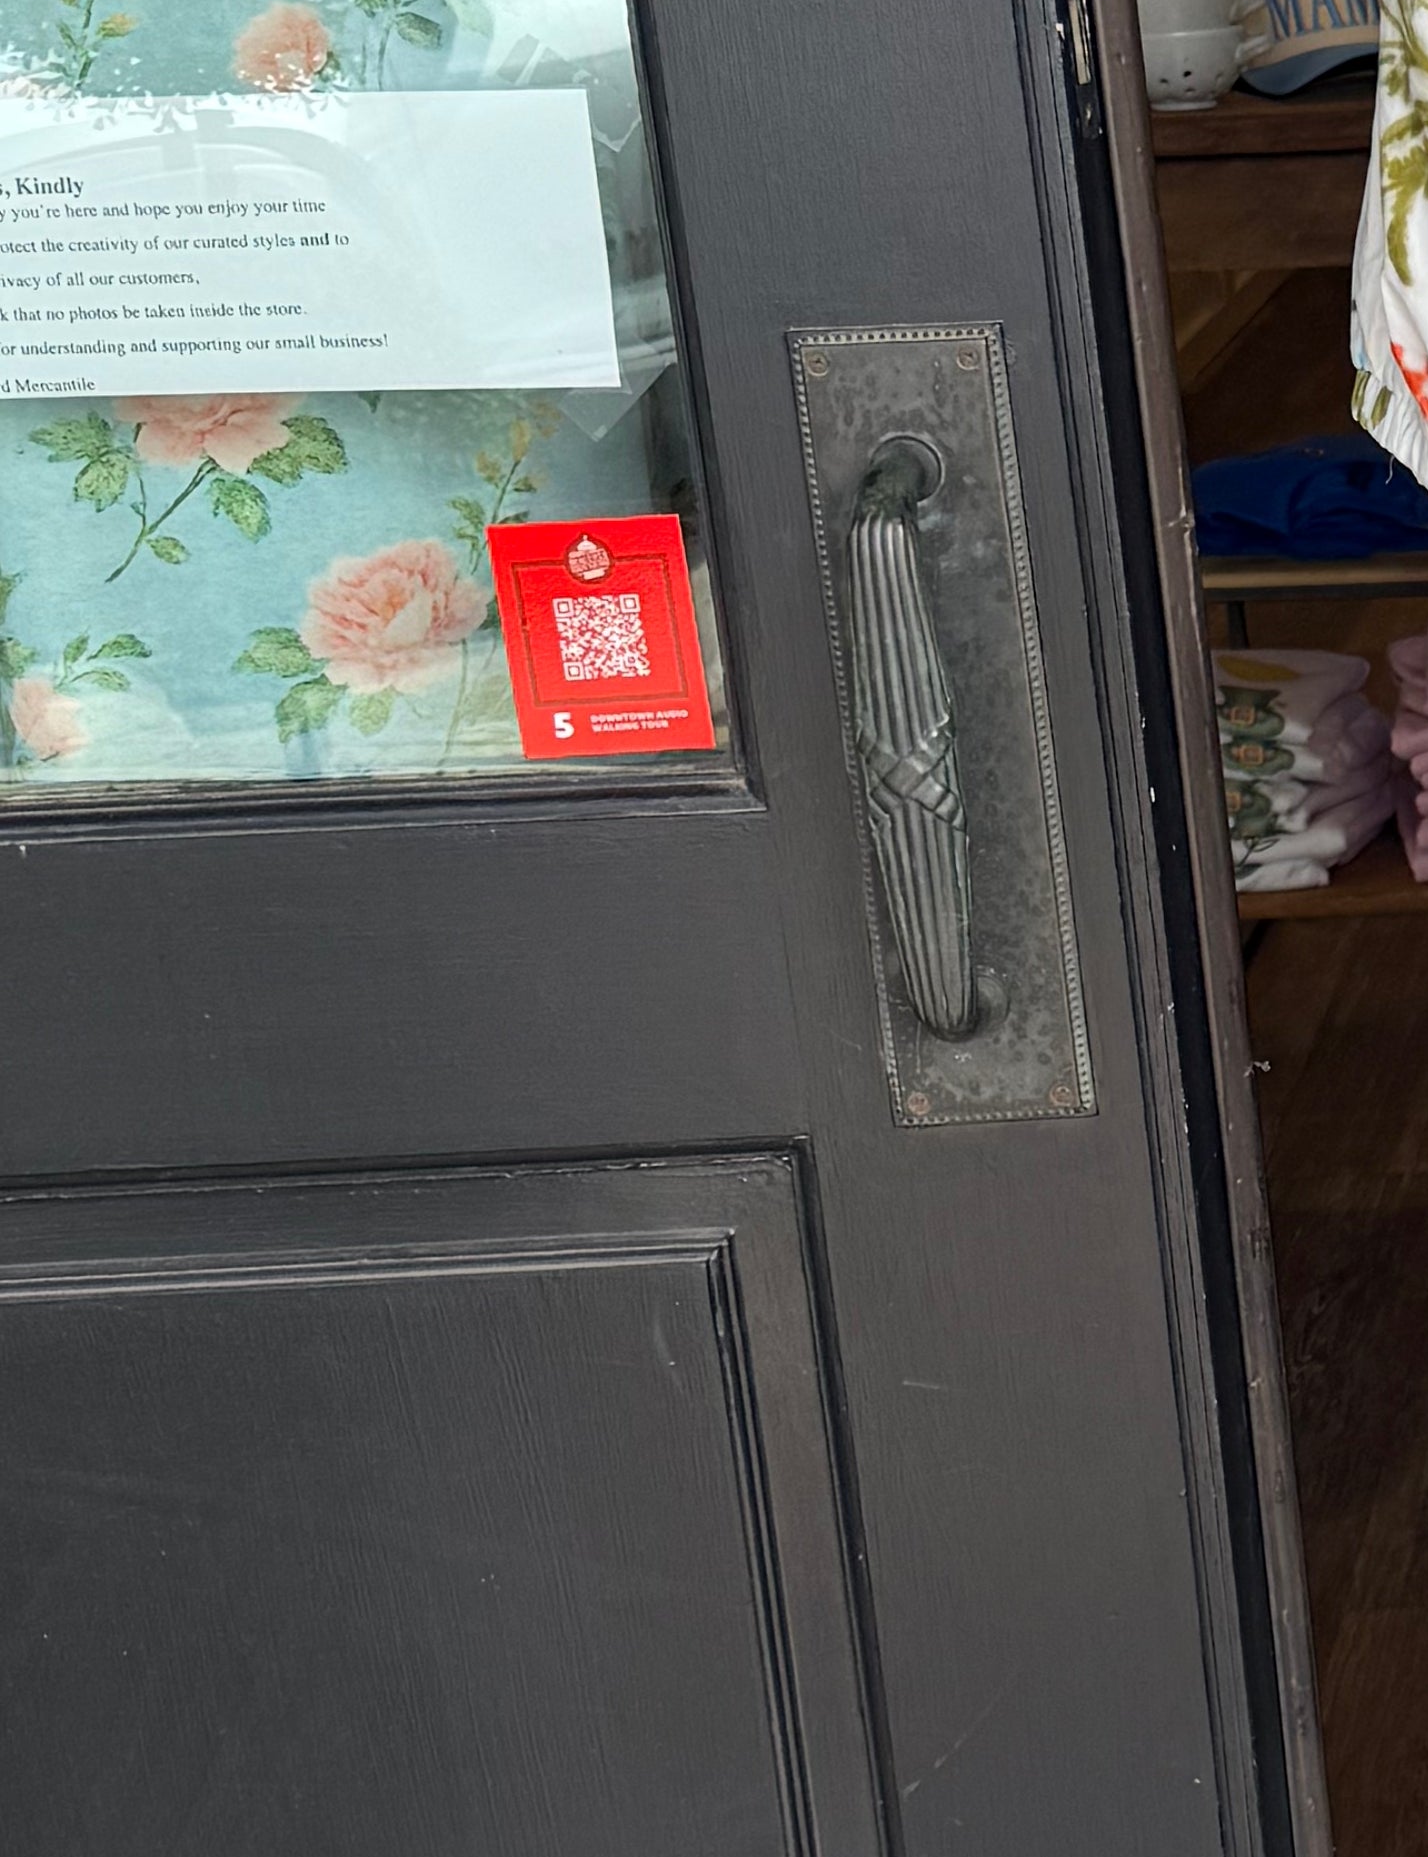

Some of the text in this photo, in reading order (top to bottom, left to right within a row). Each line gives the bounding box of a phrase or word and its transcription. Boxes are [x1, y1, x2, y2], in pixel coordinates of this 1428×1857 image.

[15, 176, 84, 198] Kindly
[11, 204, 61, 222] you're
[65, 204, 98, 217] here
[103, 203, 129, 217] and
[133, 202, 170, 219] hope
[175, 203, 203, 218] you
[208, 199, 248, 217] enjoy
[253, 202, 288, 216] your
[292, 198, 326, 213] time
[41, 238, 64, 252] the
[68, 236, 137, 254] creativity
[144, 235, 160, 250] of
[164, 239, 189, 250] our
[193, 234, 248, 249] curated
[253, 233, 295, 251] styles
[300, 233, 330, 246] and
[335, 234, 349, 245] to
[46, 272, 62, 286] of
[67, 272, 85, 286] all
[89, 274, 114, 285] our
[119, 273, 200, 285] customers,
[13, 307, 41, 321] that
[47, 310, 64, 321] no
[70, 306, 118, 324] photos
[123, 305, 140, 319] be
[145, 304, 186, 318] taken
[190, 303, 234, 317] inside
[239, 303, 261, 316] the
[267, 304, 308, 315] store.
[0, 333, 389, 357] or understanding and supporting our small business!
[15, 377, 96, 393] Mercantile
[553, 711, 575, 739] 5
[590, 709, 689, 723] DOWNTOWN AUDIO
[591, 719, 669, 733] WALKING TOUR
